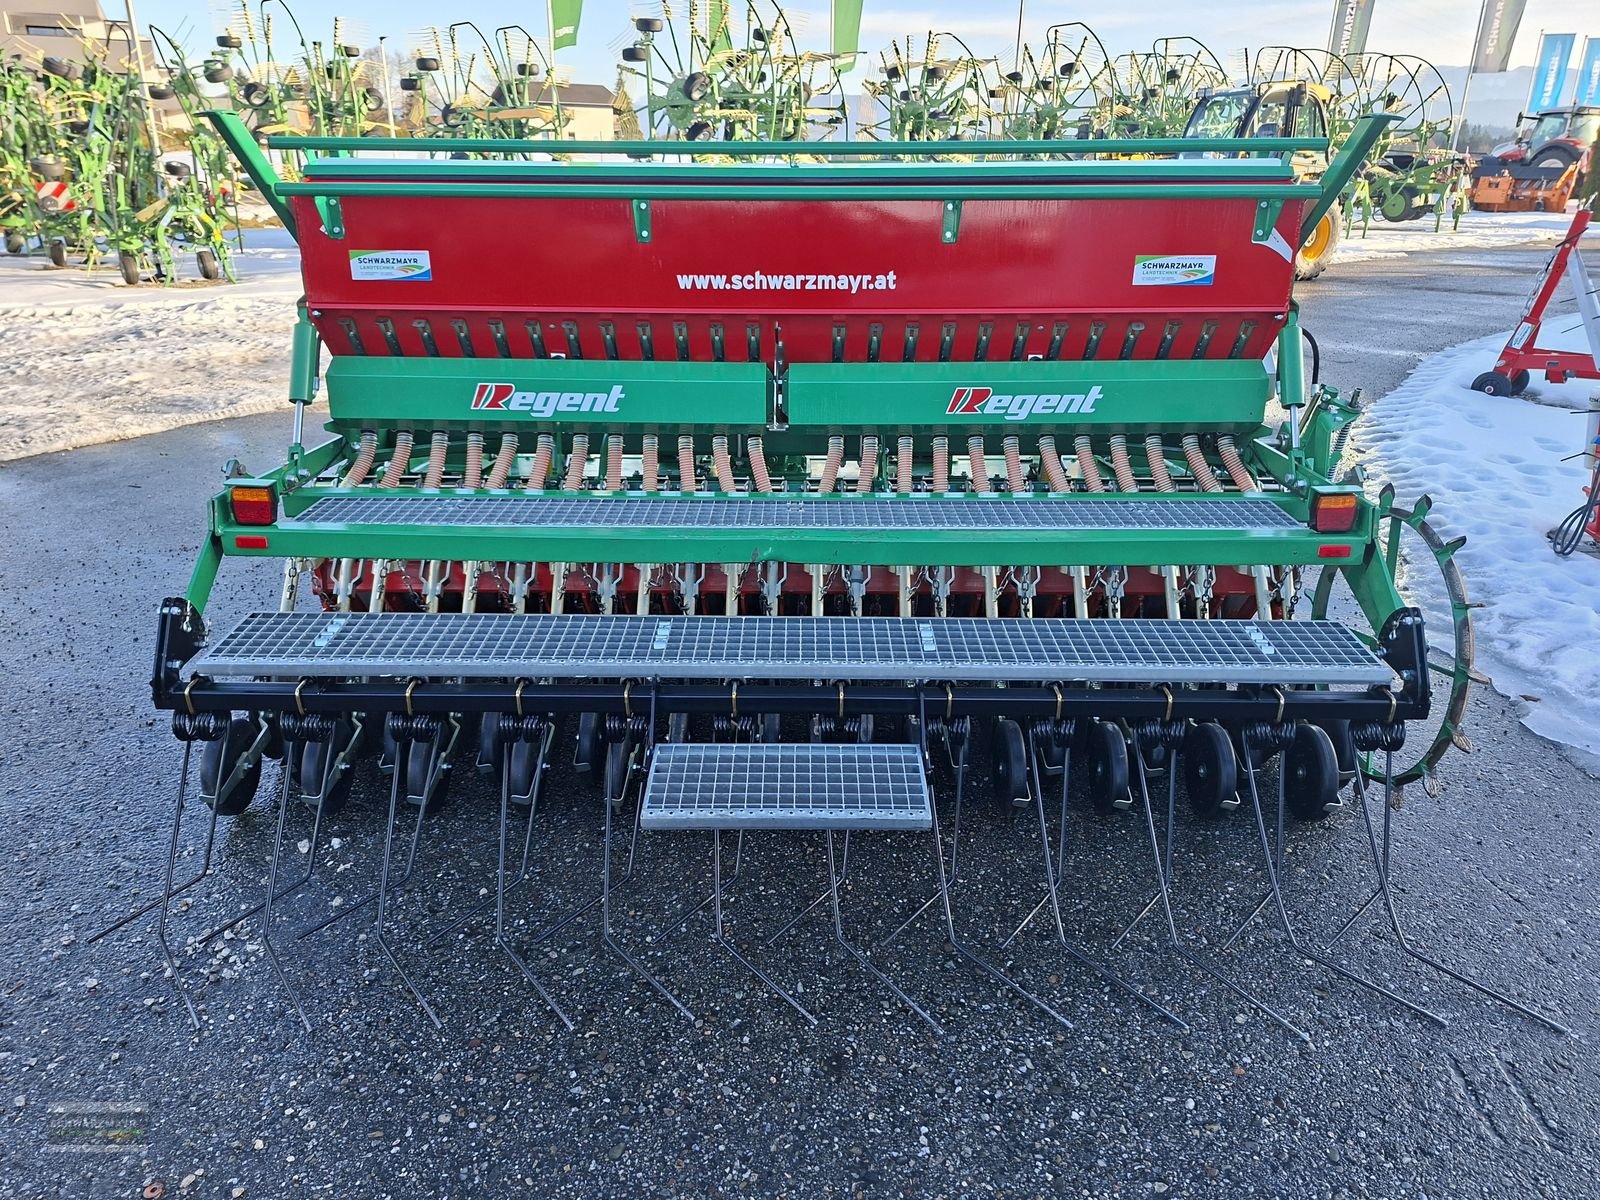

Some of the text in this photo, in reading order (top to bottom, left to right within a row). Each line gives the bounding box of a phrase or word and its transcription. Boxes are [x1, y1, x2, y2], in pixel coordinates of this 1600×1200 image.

[357, 257, 418, 265] SCHWARZMAYR
[1142, 262, 1204, 270] SCHWARZMAYR
[676, 270, 897, 294] www.schwarzmayr.at
[470, 383, 625, 418] Regent
[945, 385, 1104, 420] Regent
